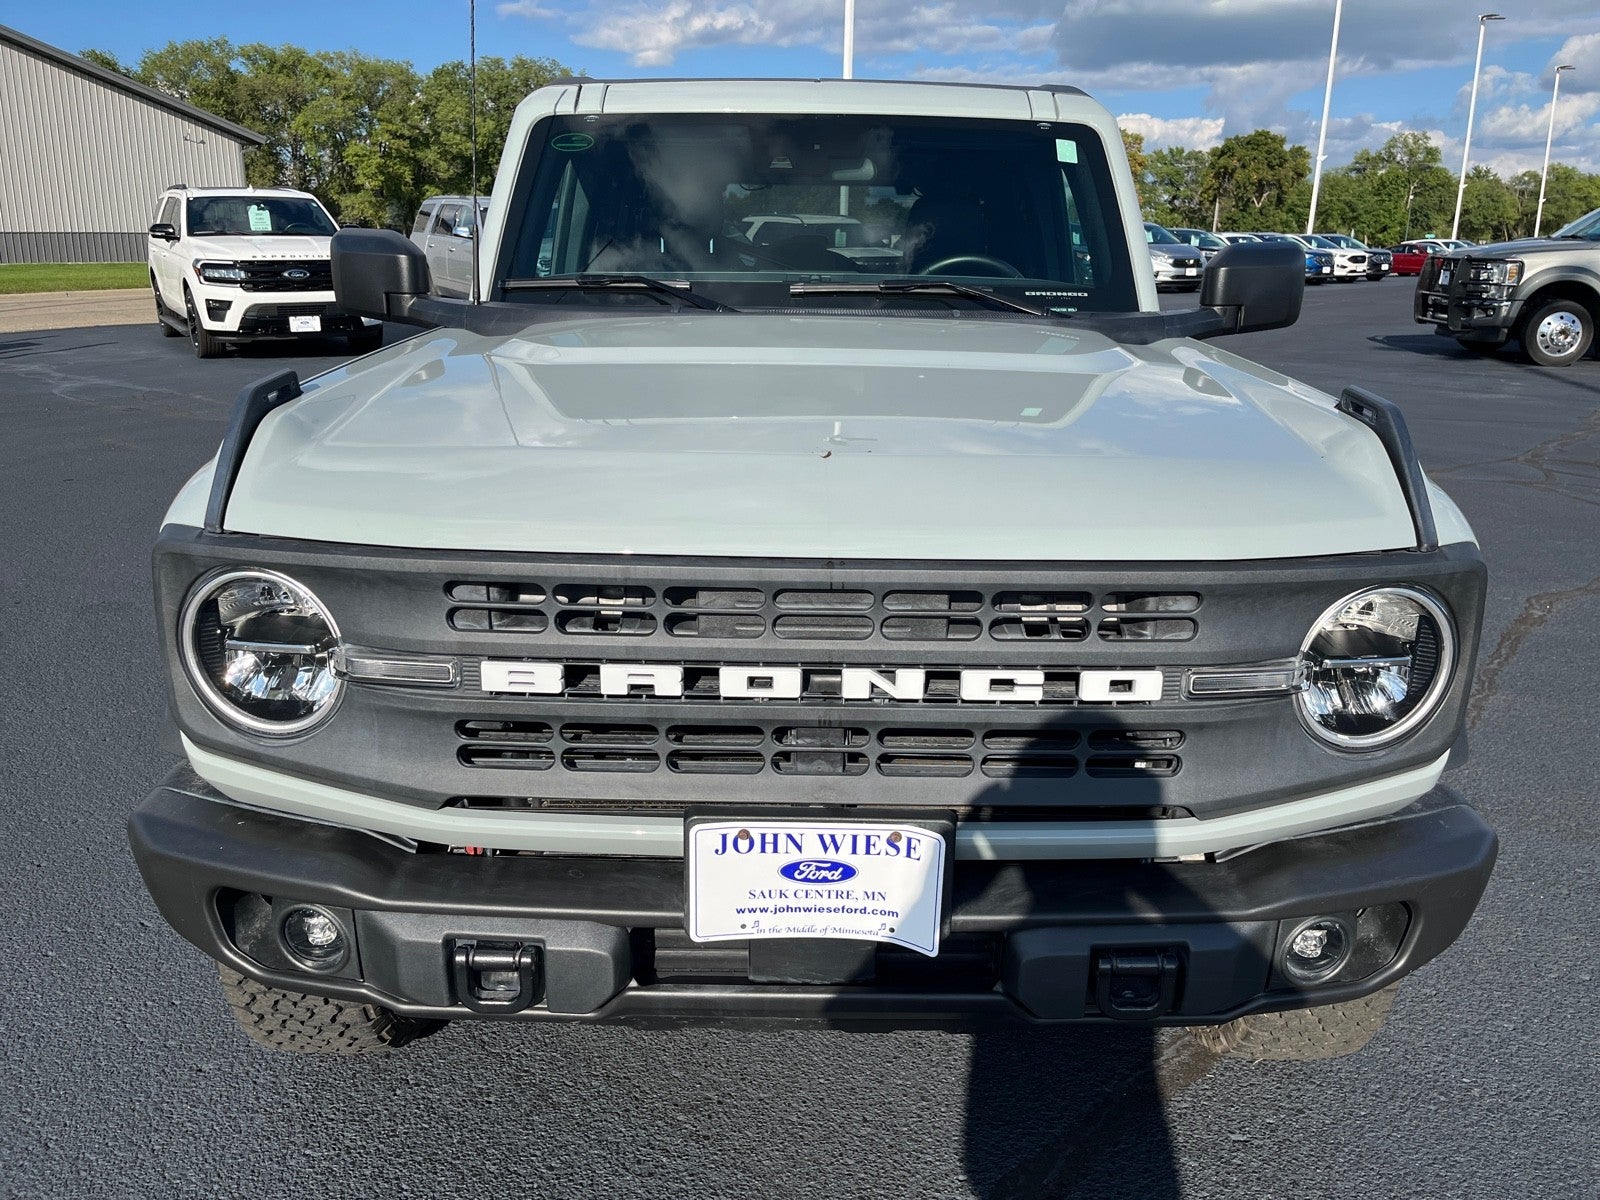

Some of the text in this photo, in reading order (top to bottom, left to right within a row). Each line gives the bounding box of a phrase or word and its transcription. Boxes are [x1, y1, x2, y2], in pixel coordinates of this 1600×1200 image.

[480, 660, 1164, 704] BRONCO
[714, 833, 922, 861] JOHN WIESE
[794, 861, 843, 881] Ford
[748, 889, 887, 902] SAUK CENTRE, MN
[735, 904, 899, 918] www.johnwieseford.com
[769, 925, 782, 934] the
[785, 925, 818, 934] Middle
[820, 925, 829, 936] of
[831, 926, 879, 937] Minnesota
